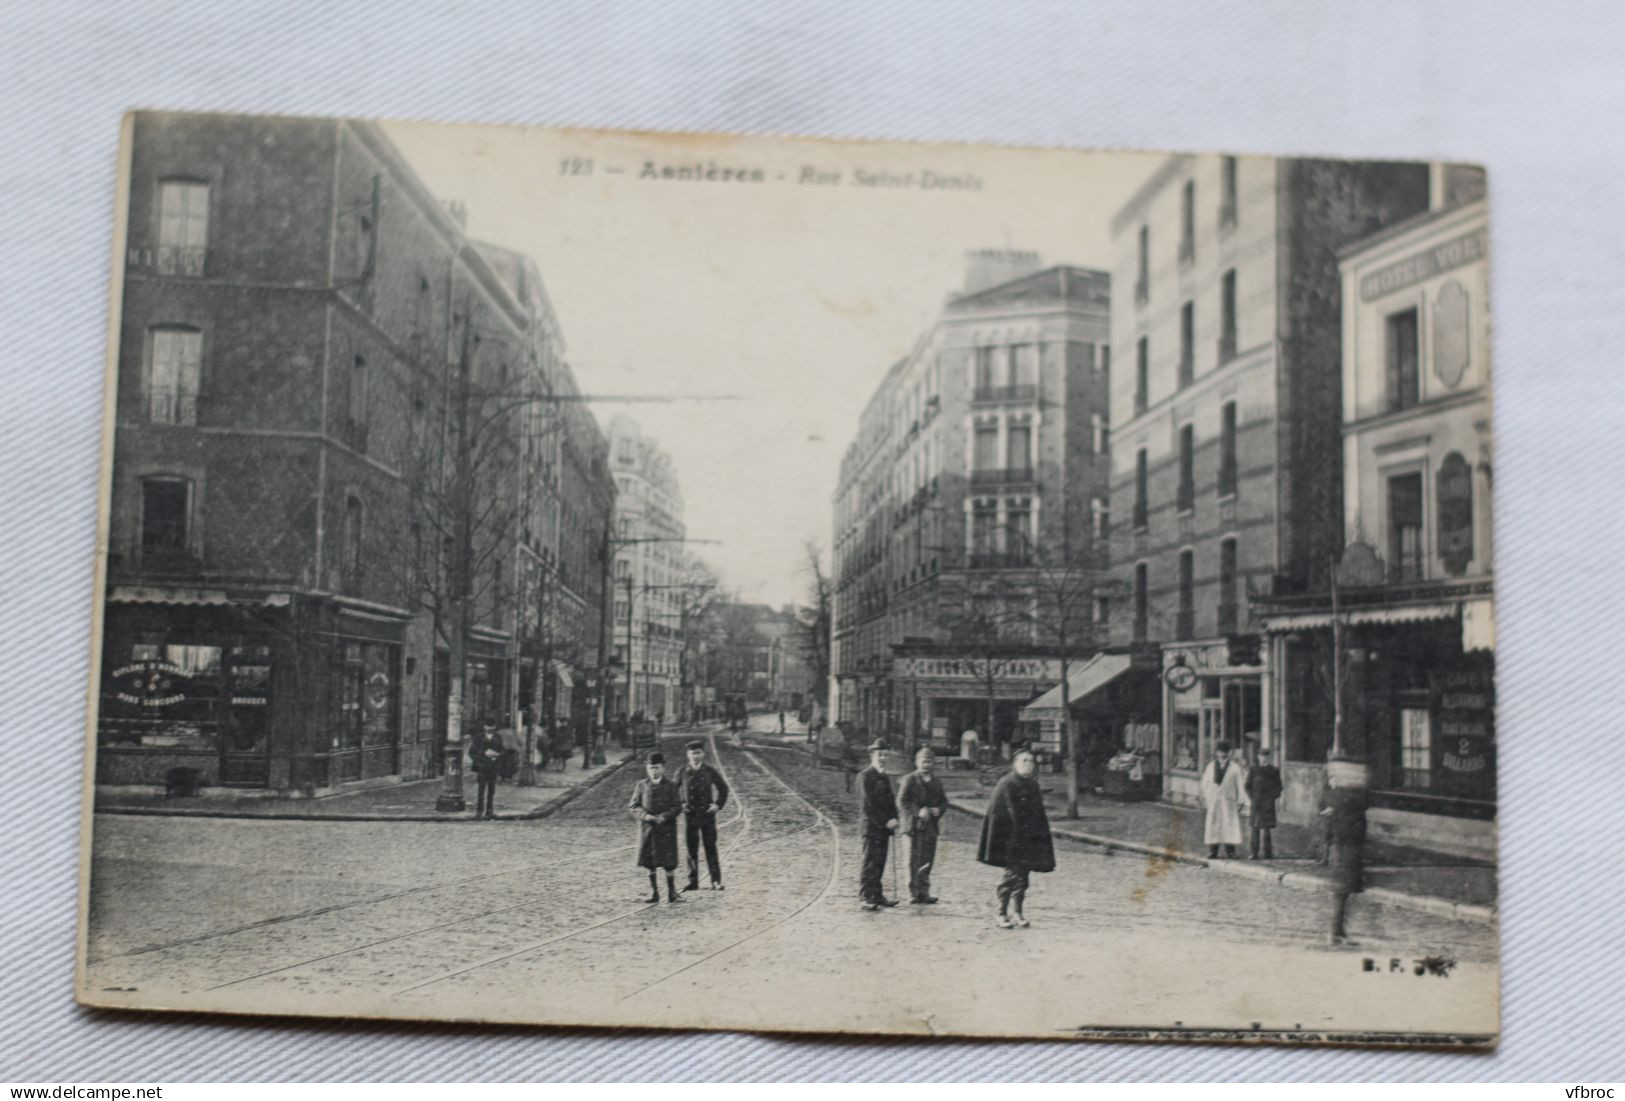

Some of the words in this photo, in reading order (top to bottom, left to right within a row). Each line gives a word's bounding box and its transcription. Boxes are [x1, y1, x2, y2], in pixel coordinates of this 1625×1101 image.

[638, 160, 766, 183] Asnières
[798, 164, 843, 187] Rue
[853, 167, 984, 192] Saint-Denis
[1459, 738, 1470, 755] 2
